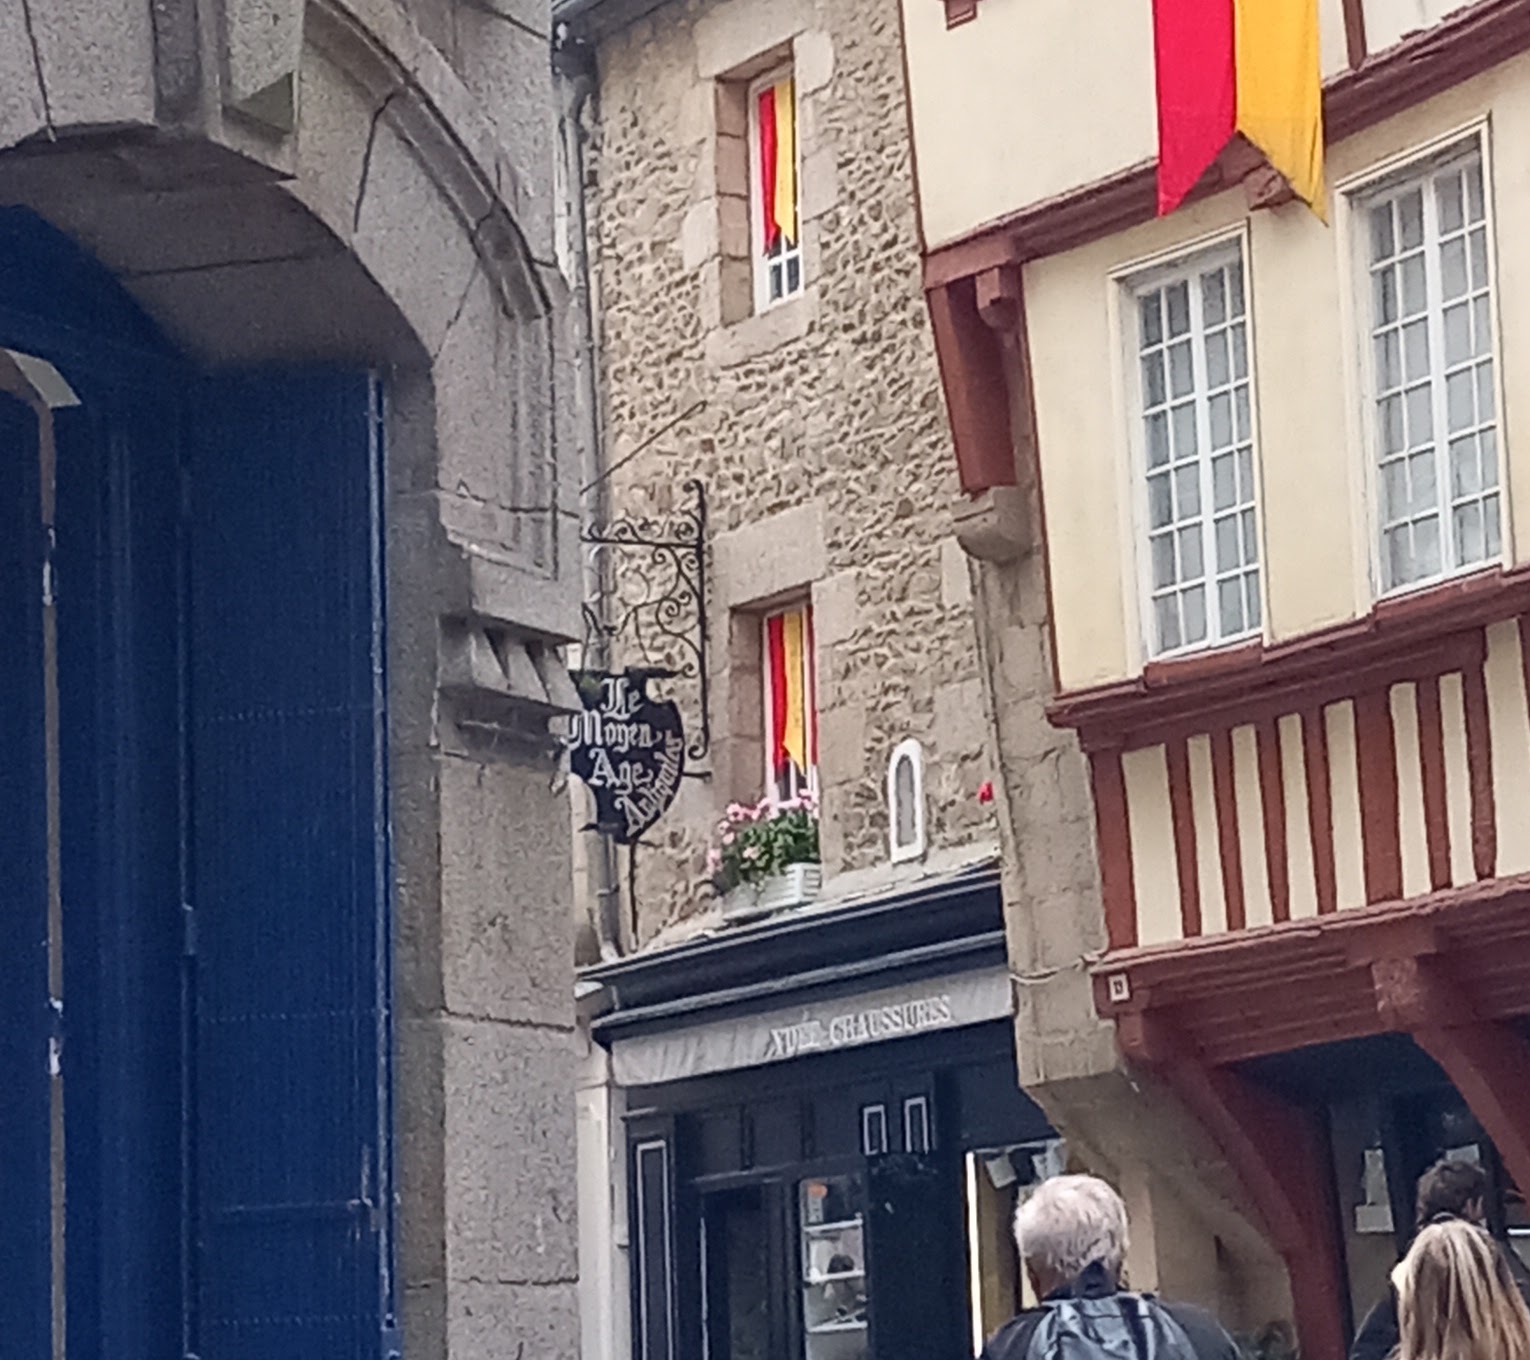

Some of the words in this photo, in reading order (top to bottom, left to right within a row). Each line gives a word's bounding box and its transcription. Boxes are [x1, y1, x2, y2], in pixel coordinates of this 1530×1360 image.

[600, 677, 645, 720] Le
[560, 709, 663, 753] Moyen
[587, 747, 654, 794] Age
